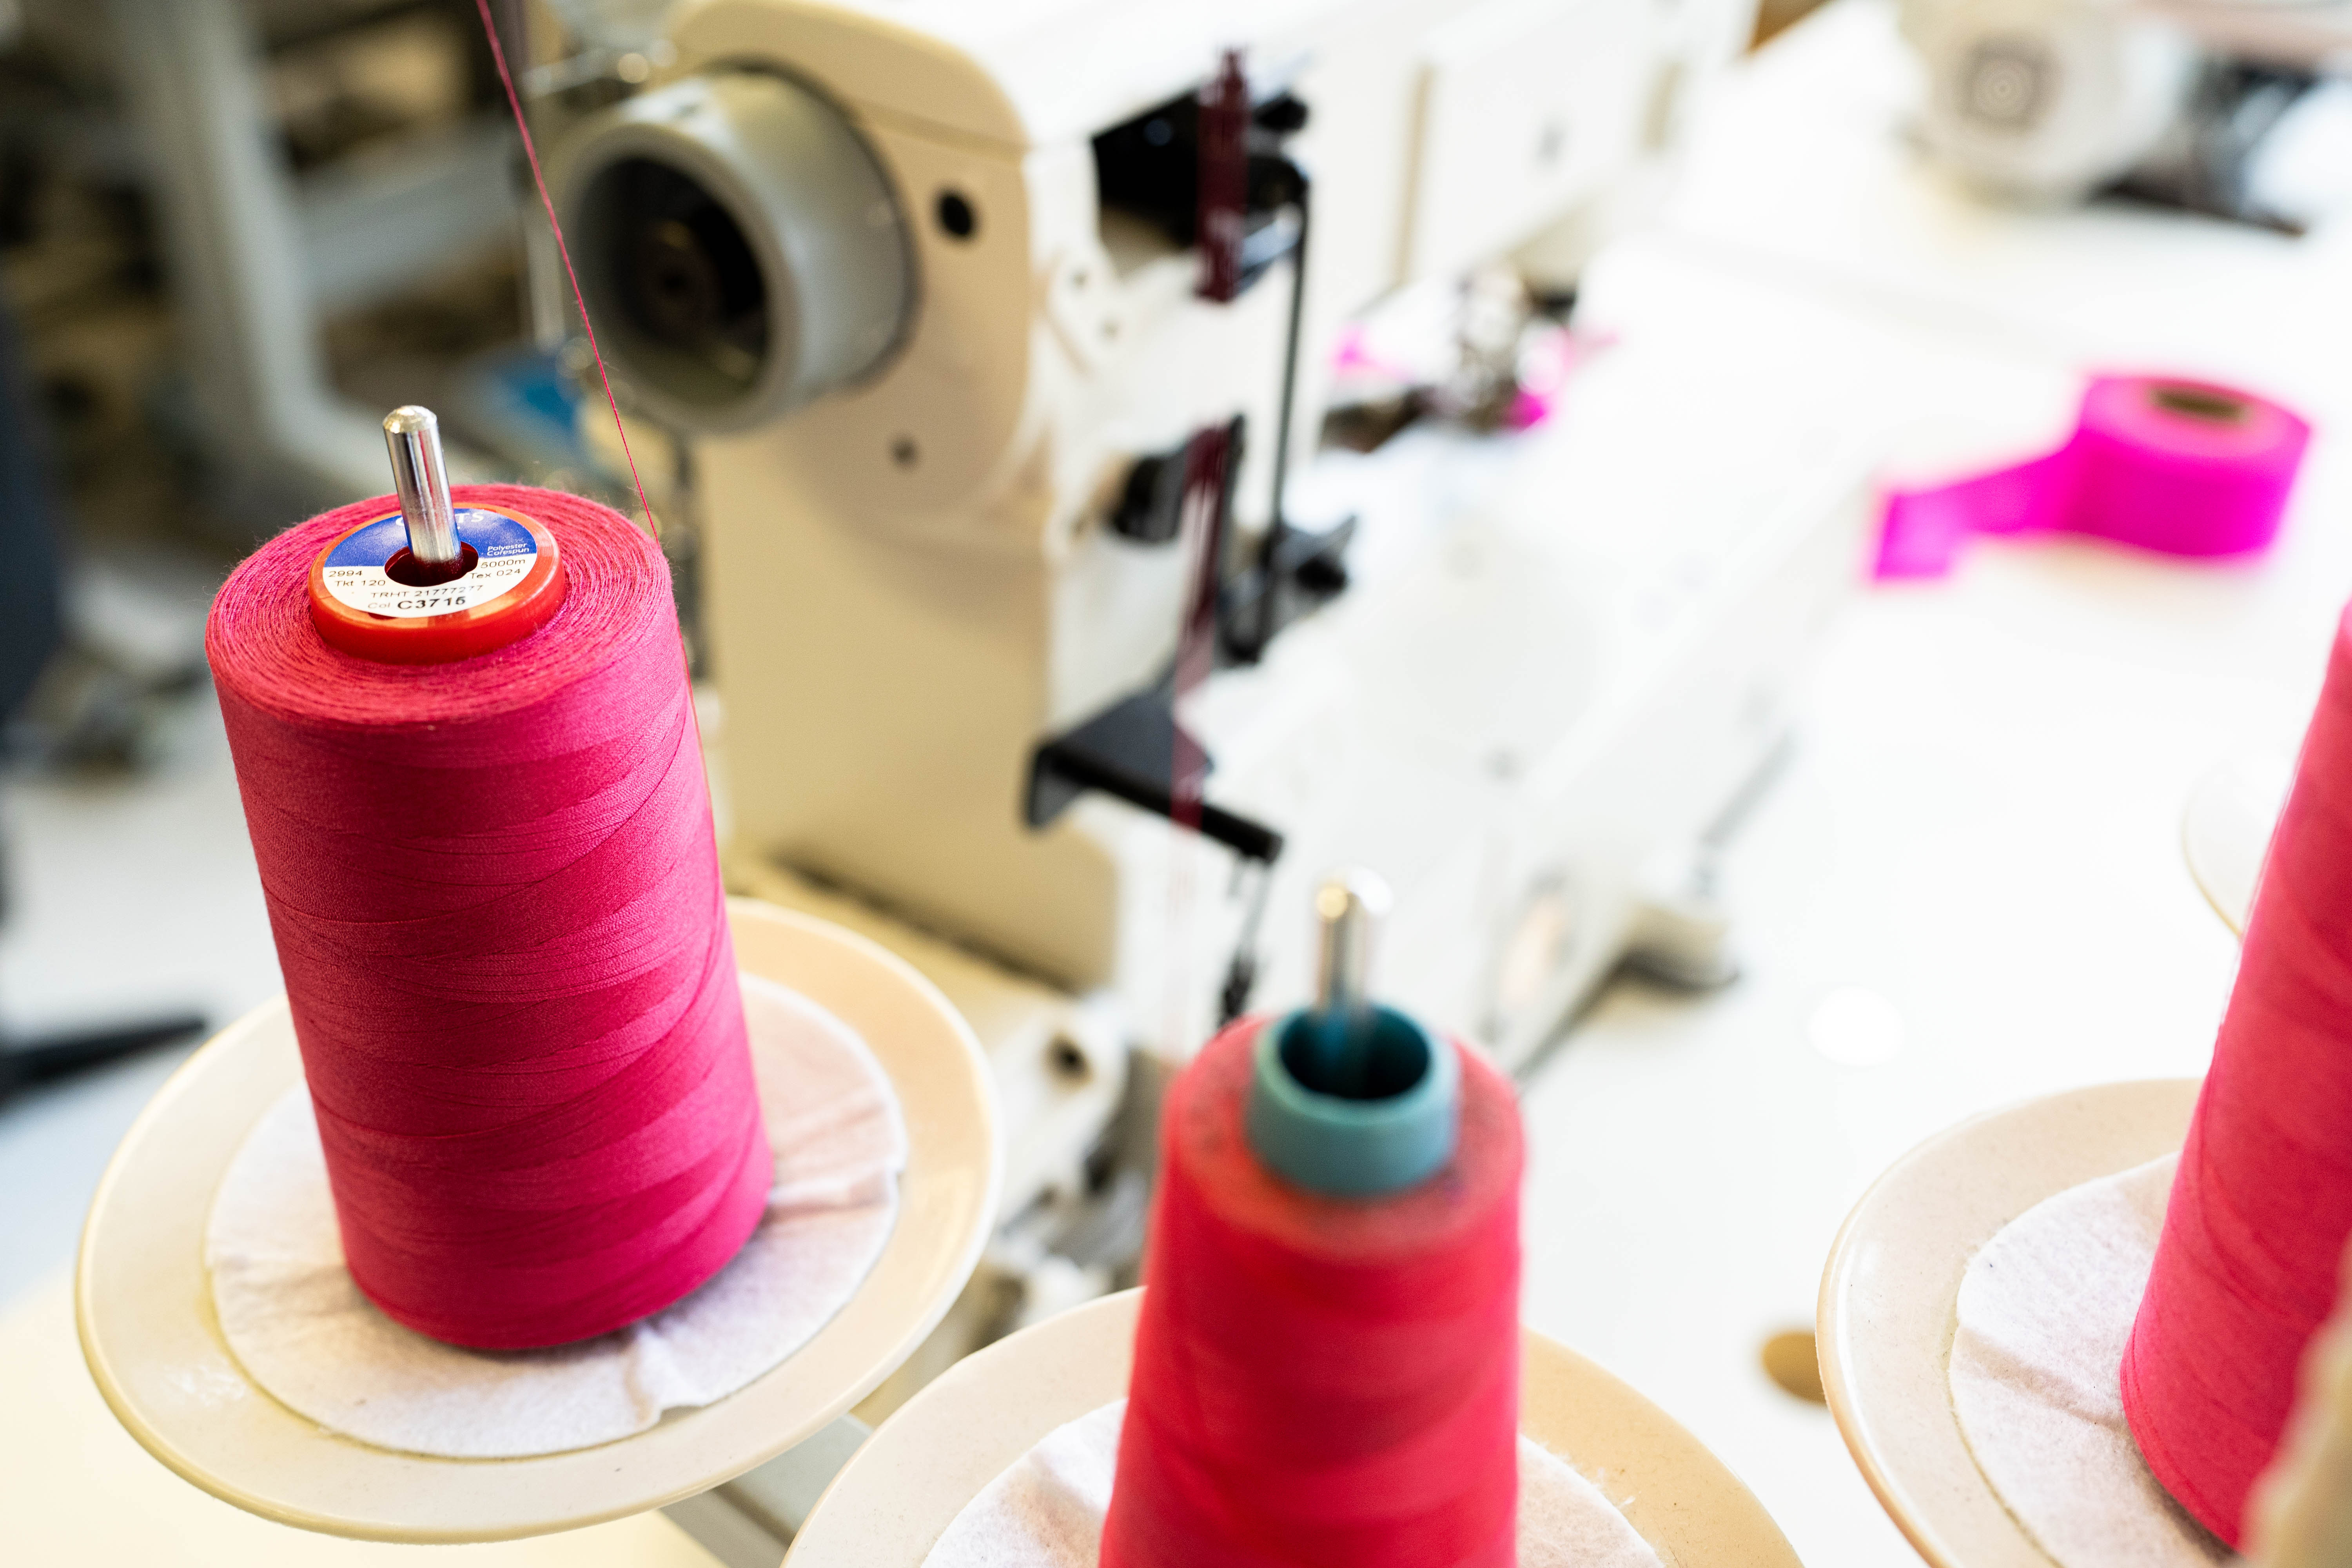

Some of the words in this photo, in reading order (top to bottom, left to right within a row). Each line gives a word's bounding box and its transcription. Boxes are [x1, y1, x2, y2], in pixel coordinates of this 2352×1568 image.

[395, 512, 484, 526] CTS
[488, 543, 527, 552] Polyester
[481, 559, 525, 568] 5000m
